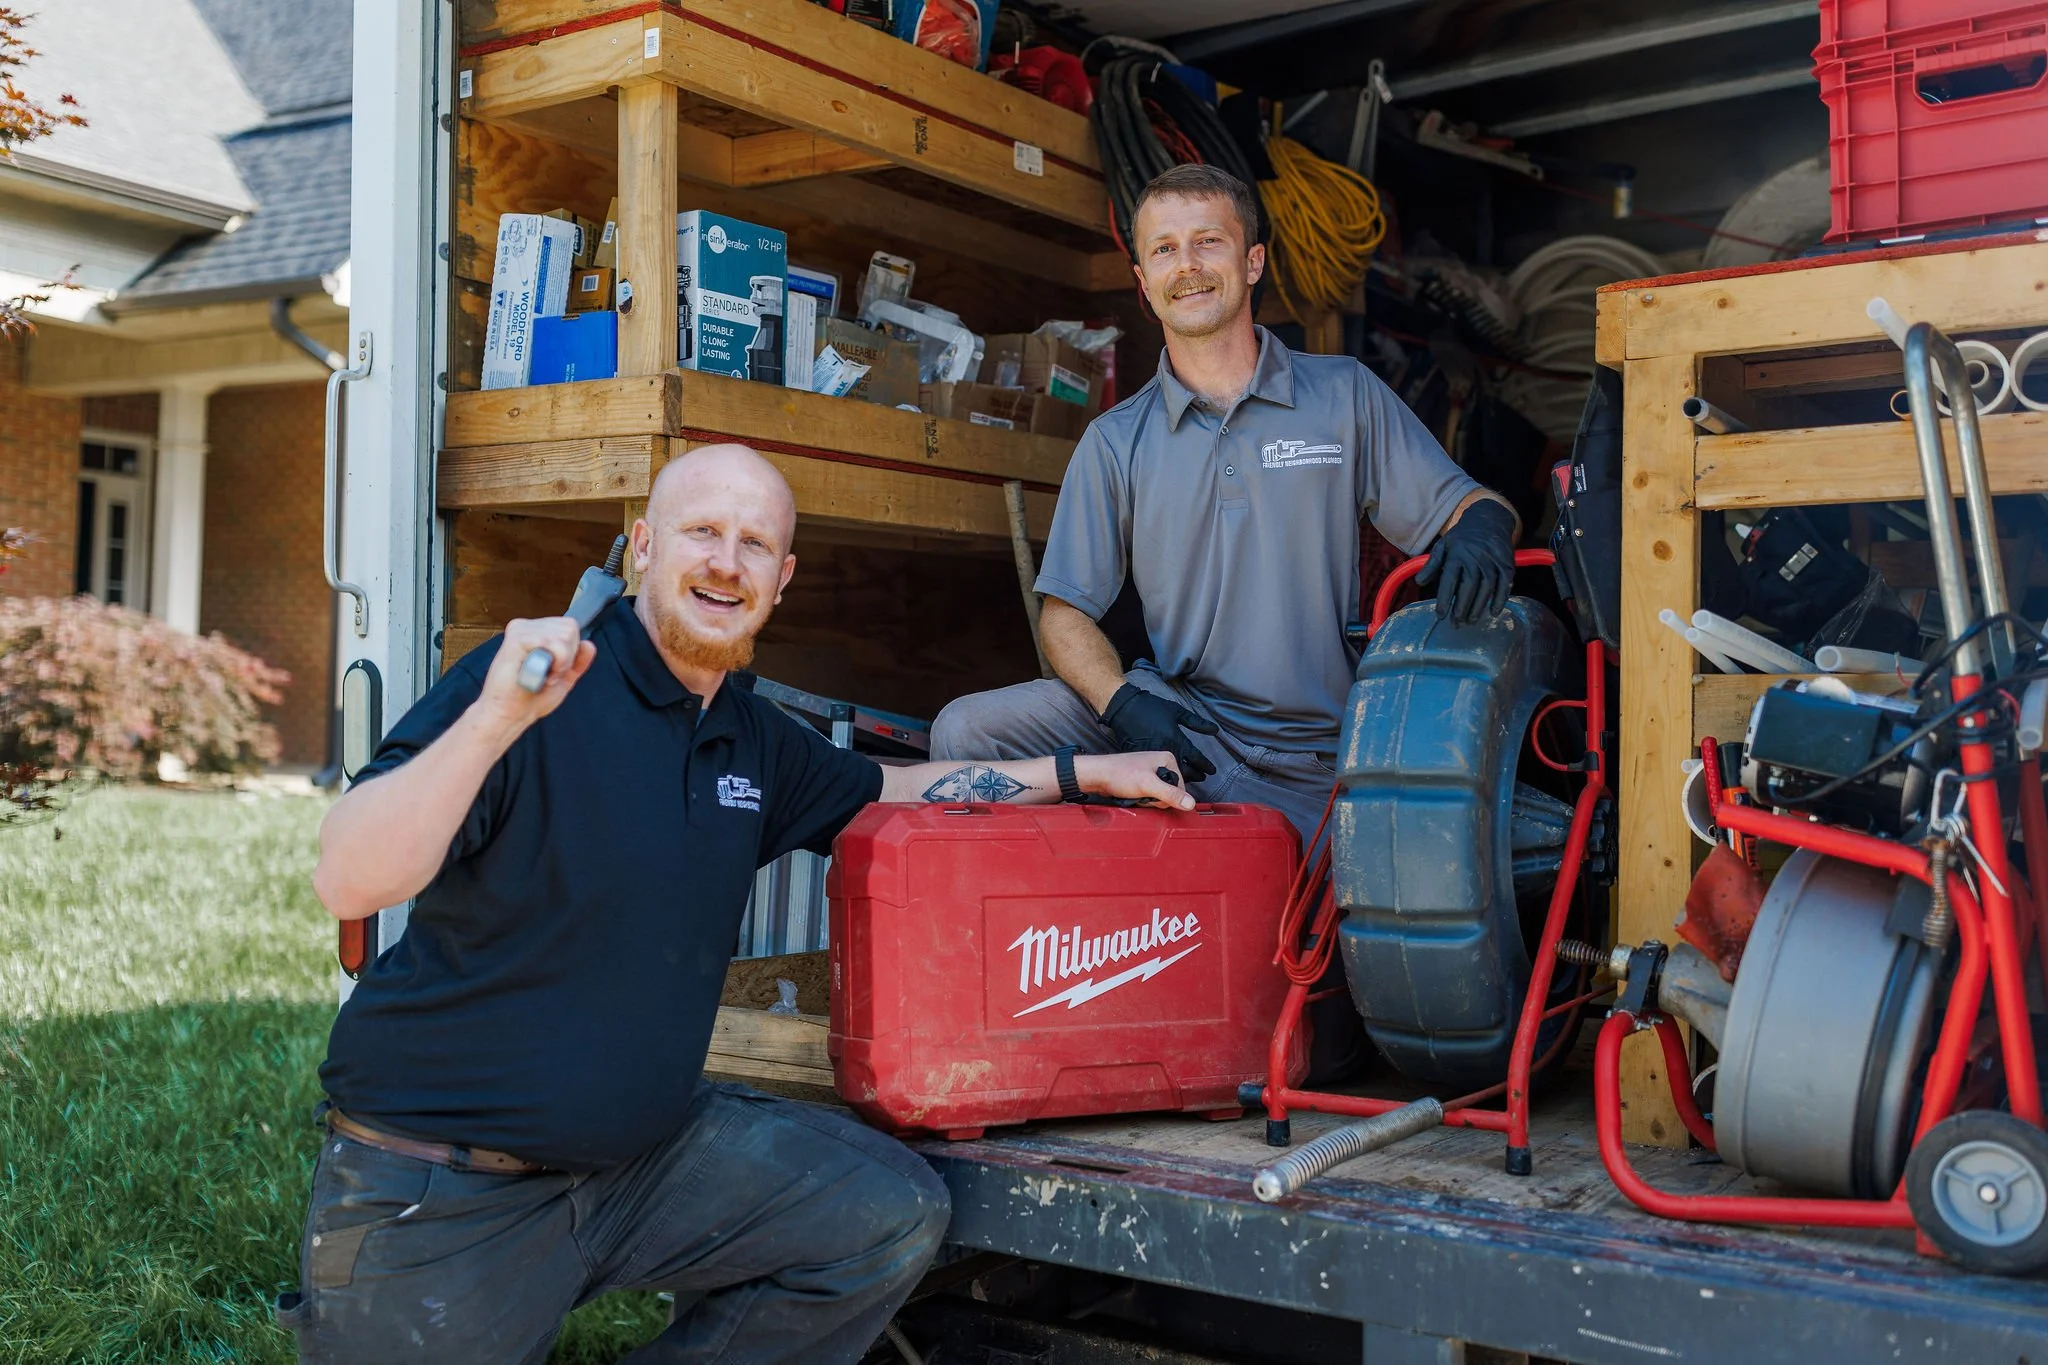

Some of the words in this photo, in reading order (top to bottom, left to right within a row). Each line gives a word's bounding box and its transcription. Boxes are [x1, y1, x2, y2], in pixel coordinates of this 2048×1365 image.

[758, 238, 770, 251] 1/2
[770, 242, 783, 253] HP
[702, 295, 750, 316] STANDARD
[702, 306, 720, 316] SERIES
[510, 303, 520, 336] MODEL
[514, 291, 530, 361] WOODFORD
[702, 322, 735, 337] DURABLE
[508, 338, 516, 348] 19
[702, 335, 708, 345] &
[708, 336, 729, 348] LONG-
[702, 347, 731, 361] LASTING
[832, 341, 877, 360] MALLEABLE
[1007, 908, 1201, 994] Milwaukee
